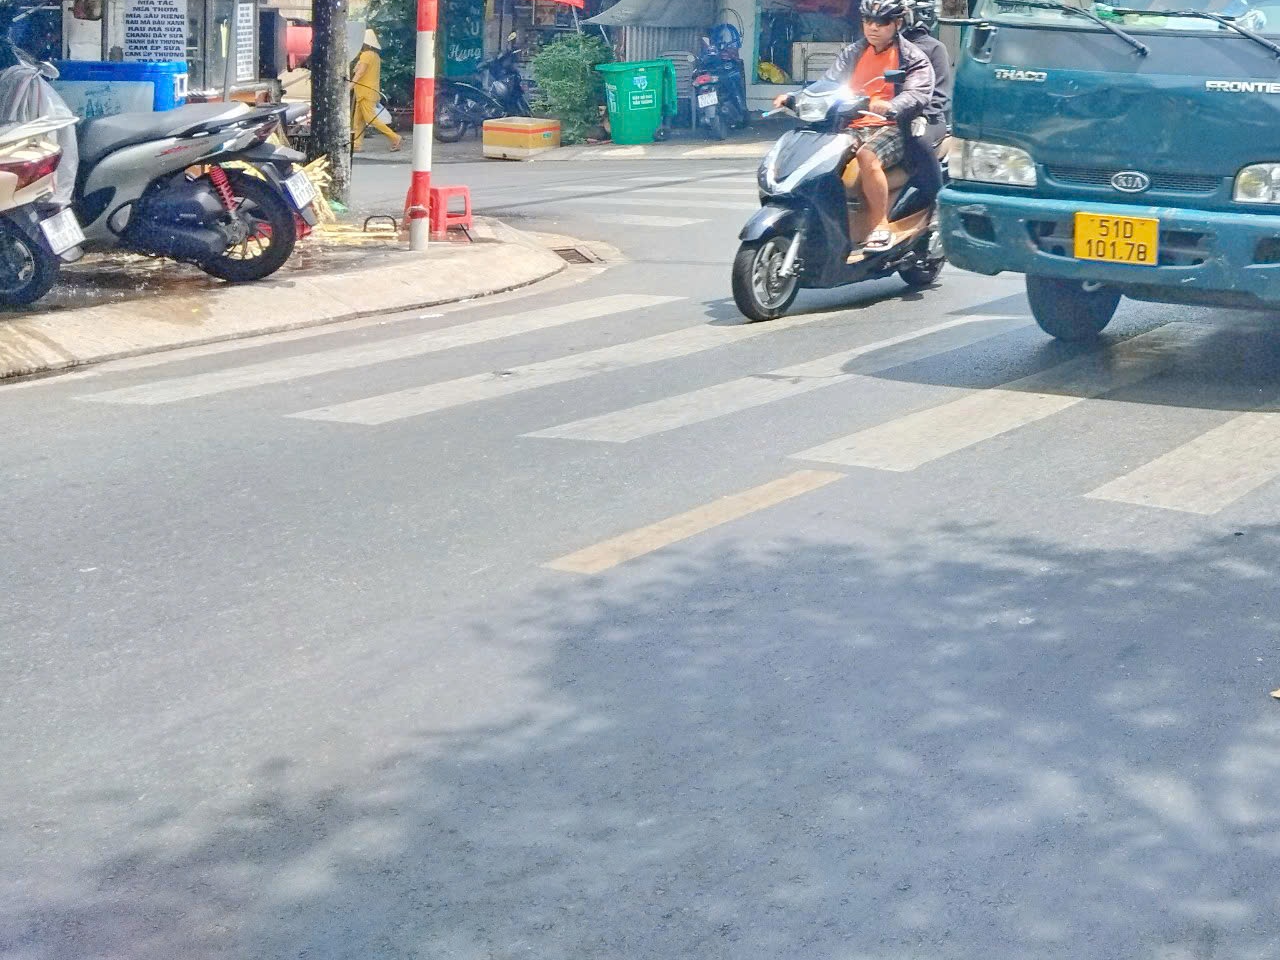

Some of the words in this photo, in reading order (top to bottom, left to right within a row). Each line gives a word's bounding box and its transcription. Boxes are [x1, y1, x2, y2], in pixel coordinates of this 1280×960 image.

[994, 68, 1048, 82] THACO
[1117, 175, 1144, 188] KIA
[1099, 219, 1134, 239] 51D
[1086, 239, 1147, 262] 101.78
